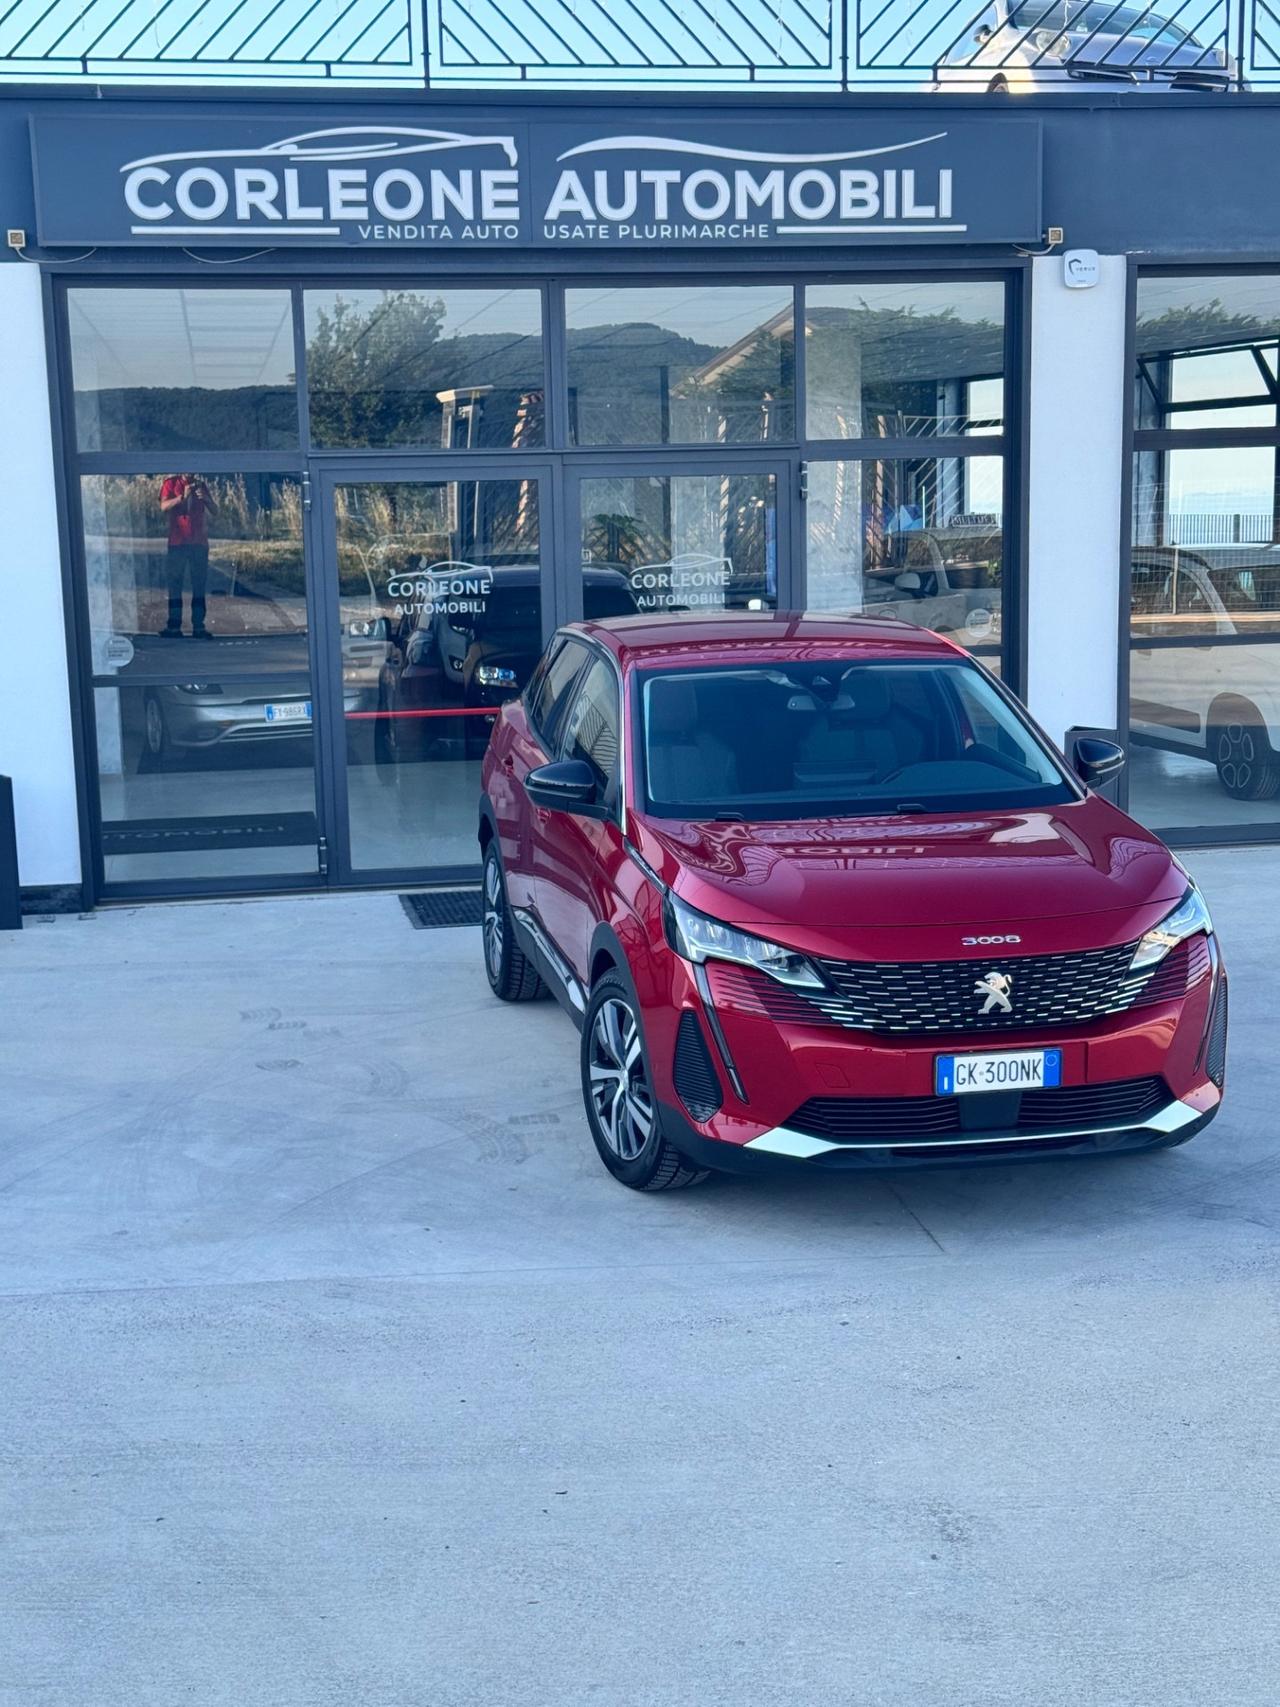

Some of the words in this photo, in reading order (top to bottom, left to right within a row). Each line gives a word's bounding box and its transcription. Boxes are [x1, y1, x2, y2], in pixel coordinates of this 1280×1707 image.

[124, 167, 520, 221] CORLEONE
[544, 169, 952, 220] AUTOMOBILI
[358, 224, 453, 240] VENDITA
[461, 224, 519, 240] AUTO
[544, 224, 610, 240] USATE
[618, 223, 769, 239] PLURIMARCHE
[387, 578, 492, 598] CORLEONE
[631, 571, 731, 589] CORLEONE
[394, 601, 487, 616] AUTOMOBILI
[636, 593, 726, 608] AUTOMOBILI
[961, 934, 1022, 946] 3008
